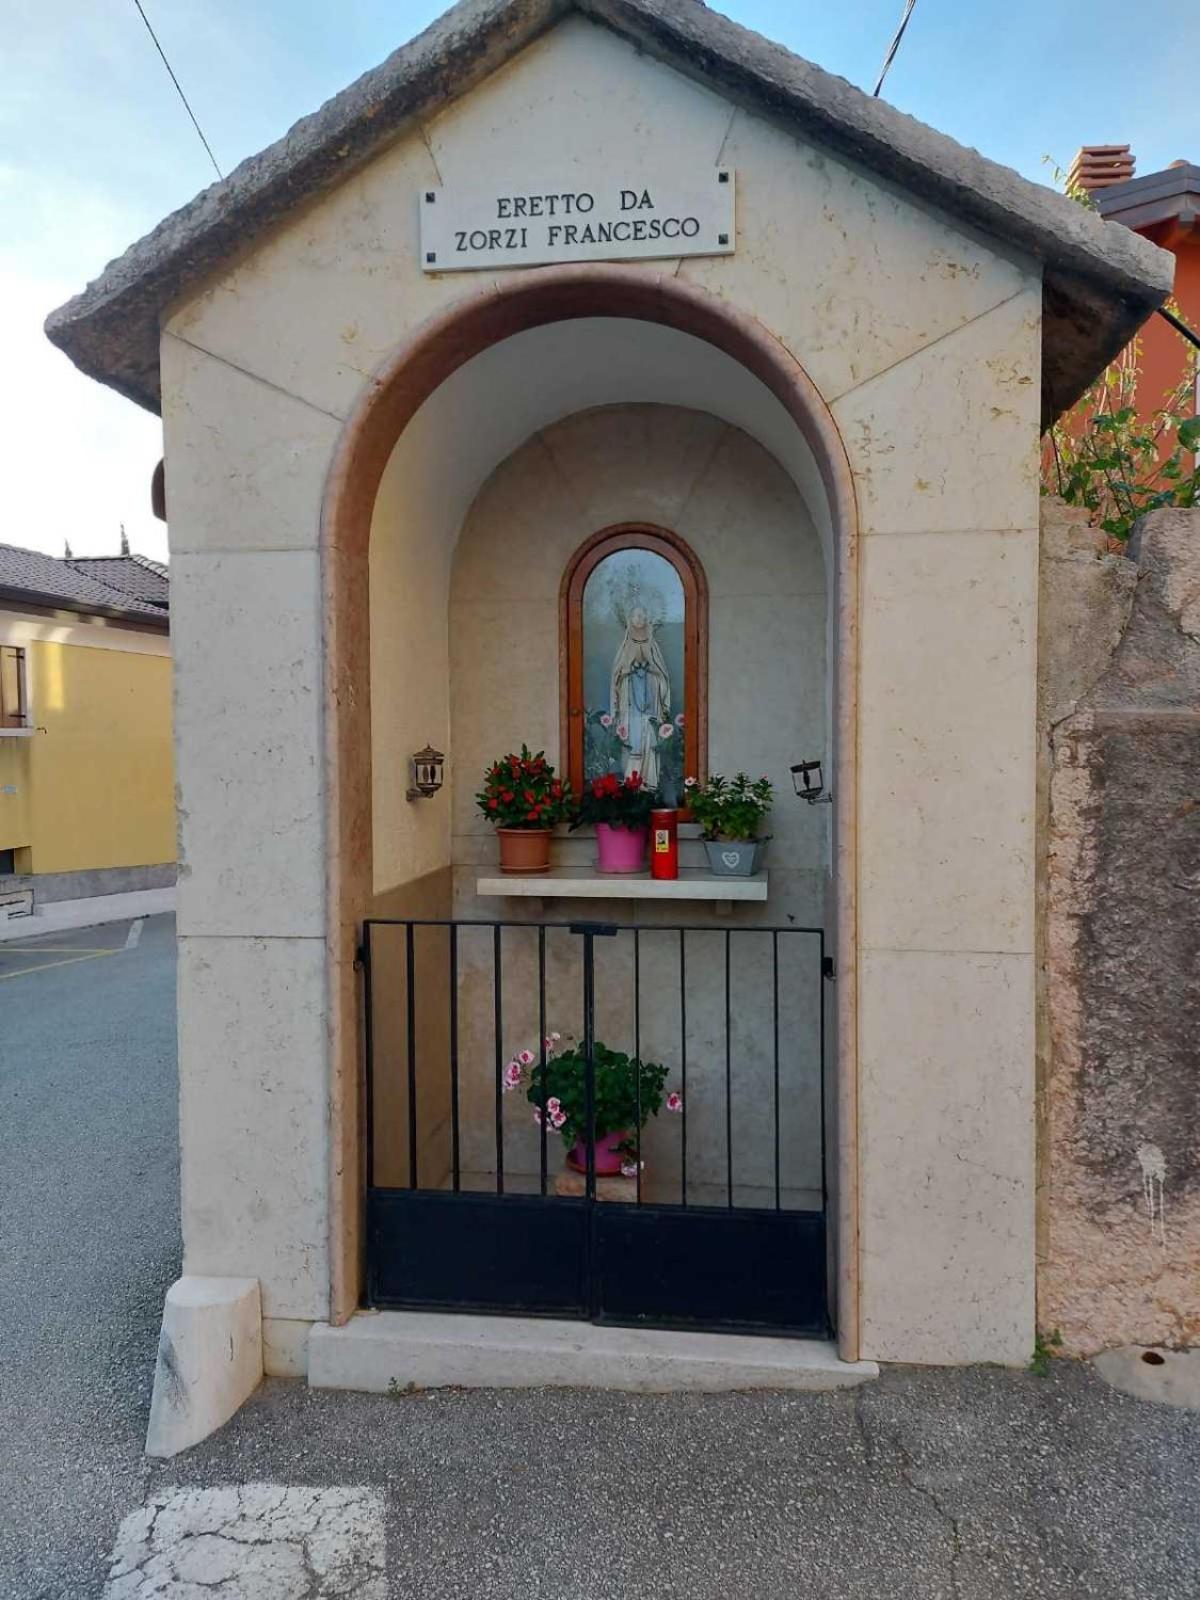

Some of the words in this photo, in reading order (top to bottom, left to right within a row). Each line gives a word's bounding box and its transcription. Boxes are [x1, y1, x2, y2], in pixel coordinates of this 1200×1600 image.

[497, 192, 594, 218] ERETTO
[620, 189, 654, 210] DA
[455, 228, 528, 251] ZORZI
[547, 217, 700, 246] FRANCESCO
